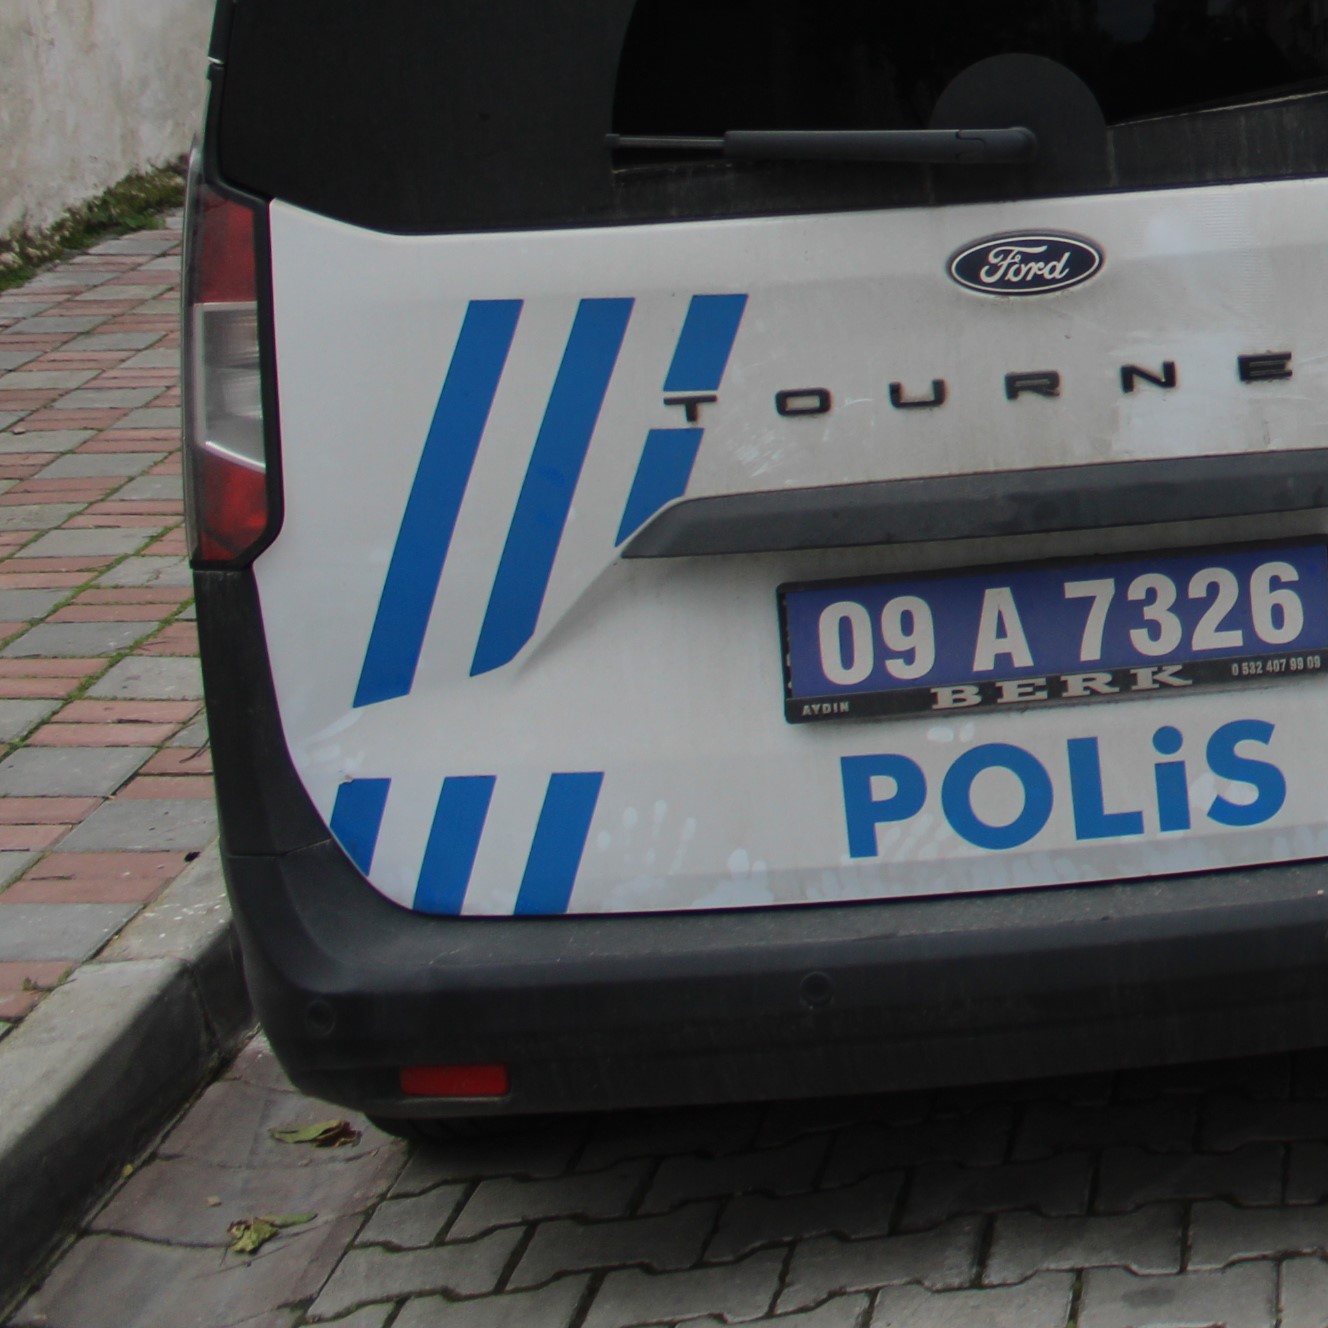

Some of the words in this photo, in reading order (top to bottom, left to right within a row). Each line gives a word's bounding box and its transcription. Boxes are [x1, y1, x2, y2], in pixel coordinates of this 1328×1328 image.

[979, 244, 1072, 284] Ford
[818, 594, 936, 686] 09
[972, 586, 1035, 673] A
[1064, 560, 1306, 663] 7326
[801, 700, 851, 717] AYDIN
[930, 664, 1193, 711] BERK
[1242, 661, 1264, 676] 532
[1266, 658, 1287, 673] 407
[1307, 655, 1321, 669] 09
